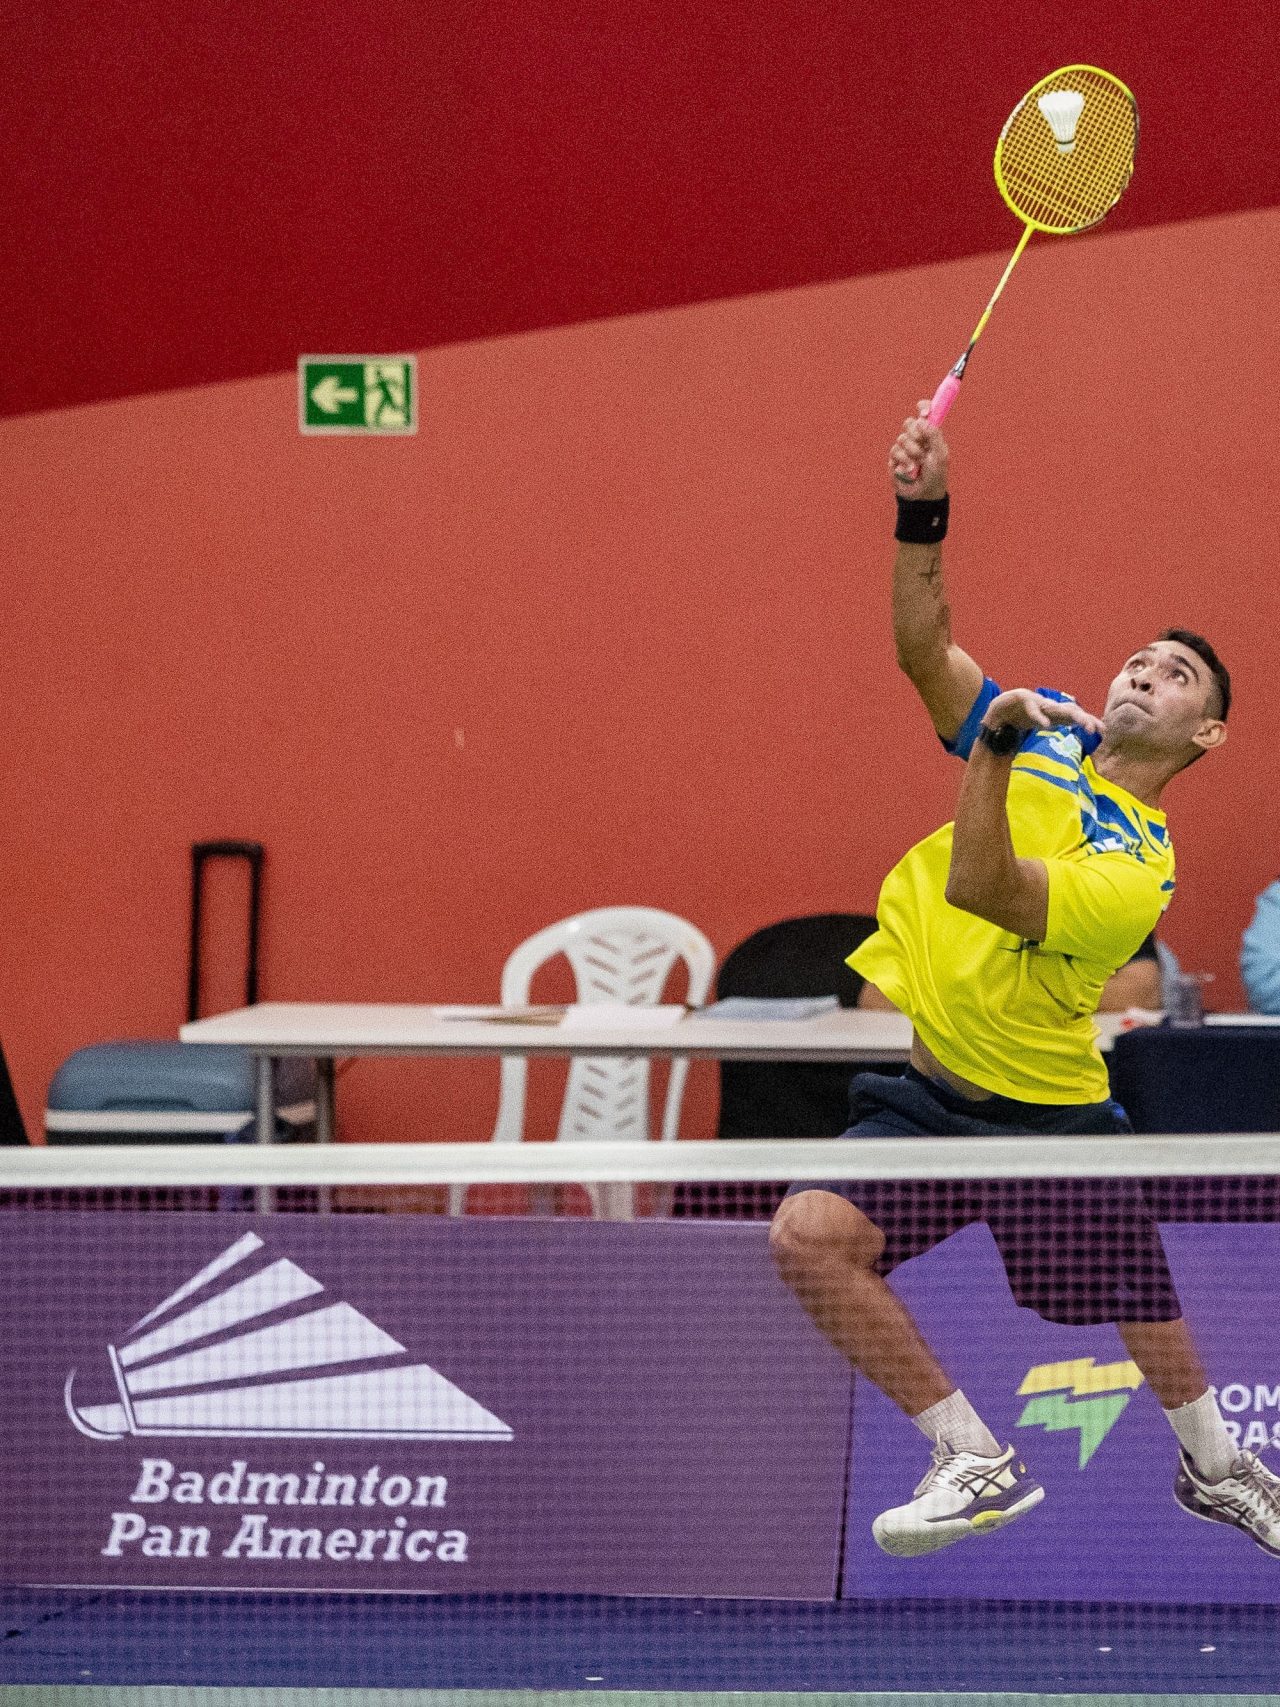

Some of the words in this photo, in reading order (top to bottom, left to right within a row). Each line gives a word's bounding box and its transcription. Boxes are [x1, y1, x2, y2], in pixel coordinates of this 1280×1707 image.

[131, 1459, 447, 1507] Badminton
[102, 1513, 210, 1557] Pan
[223, 1515, 468, 1561] America
